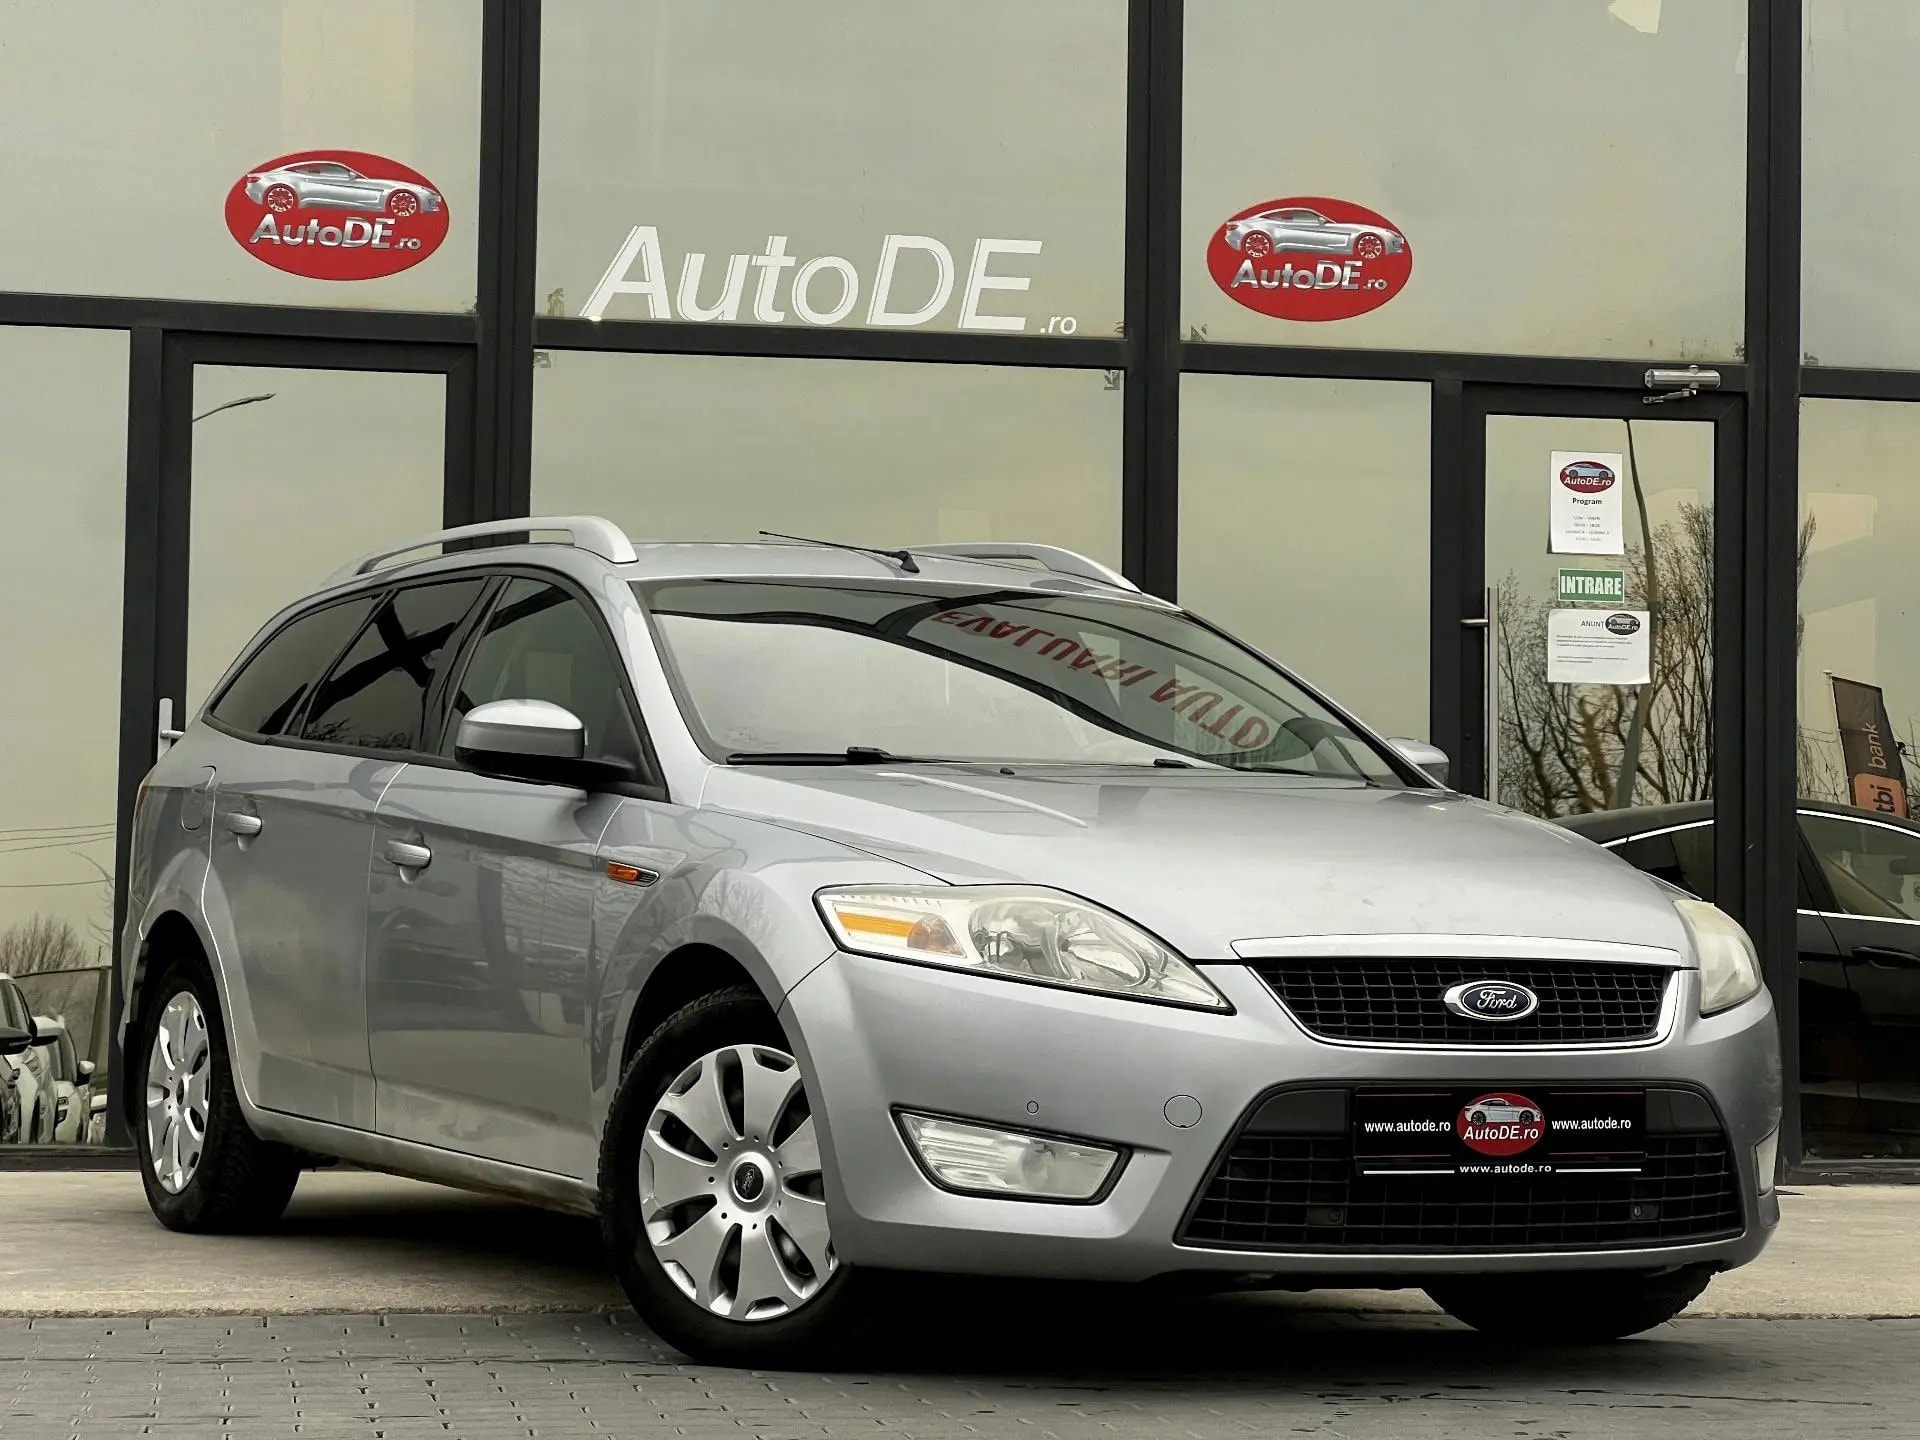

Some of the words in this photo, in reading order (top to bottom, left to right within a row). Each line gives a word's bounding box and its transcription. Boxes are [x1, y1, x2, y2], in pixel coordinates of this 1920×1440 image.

[1564, 477, 1612, 486] AutoDE.ro
[1572, 497, 1603, 506] Program
[1560, 575, 1622, 595] INTRARE
[1861, 722, 1887, 770] bank
[1477, 989, 1518, 1009] Ford
[1364, 1118, 1451, 1133] www.autode.ro
[1551, 1117, 1632, 1130] www.autode.ro
[1463, 1125, 1539, 1141] AutoDE.ro
[1459, 1163, 1552, 1174] www.autode.ro
